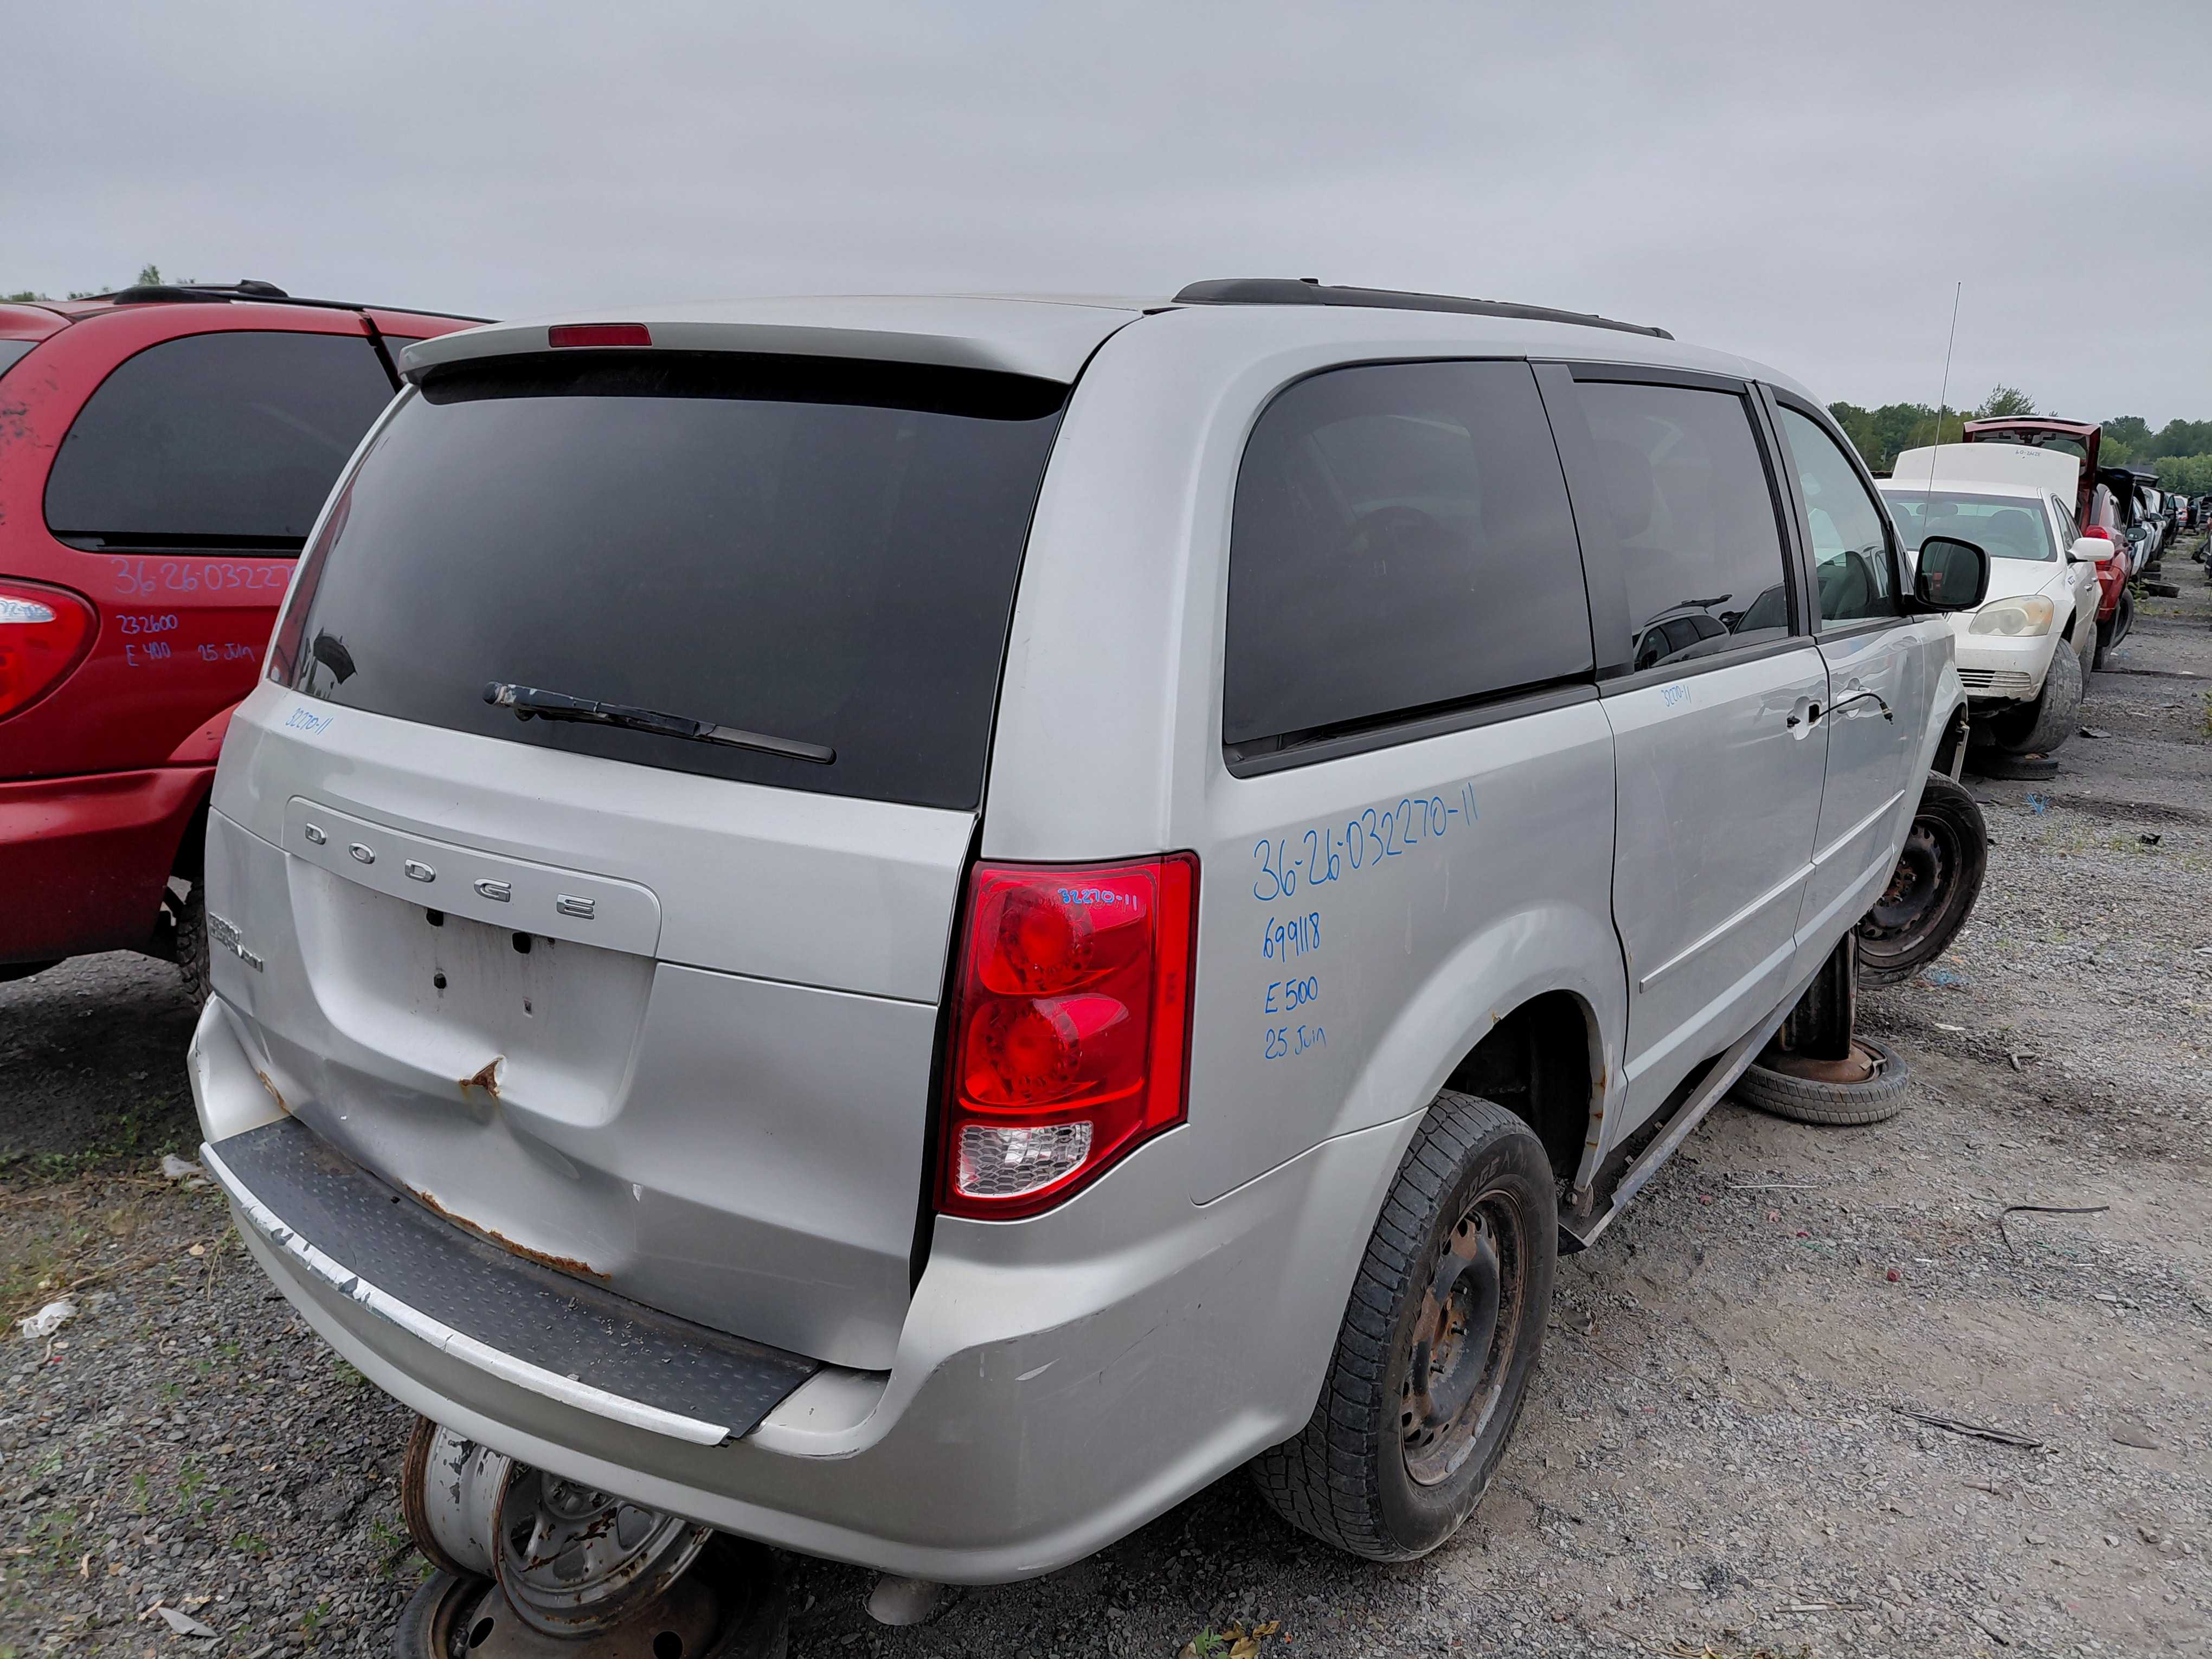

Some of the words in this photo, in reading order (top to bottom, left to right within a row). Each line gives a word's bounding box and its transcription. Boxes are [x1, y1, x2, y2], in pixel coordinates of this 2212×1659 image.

[111, 557, 298, 597] 36-26-03227
[115, 614, 178, 634] 232600
[125, 644, 139, 666] E
[305, 822, 595, 920] DODGE
[1057, 887, 1138, 912] 32270-11
[1263, 912, 1320, 963] 699118
[1265, 981, 1282, 1014] E
[1285, 976, 1319, 1011] 500
[1265, 1026, 1288, 1059] 25
